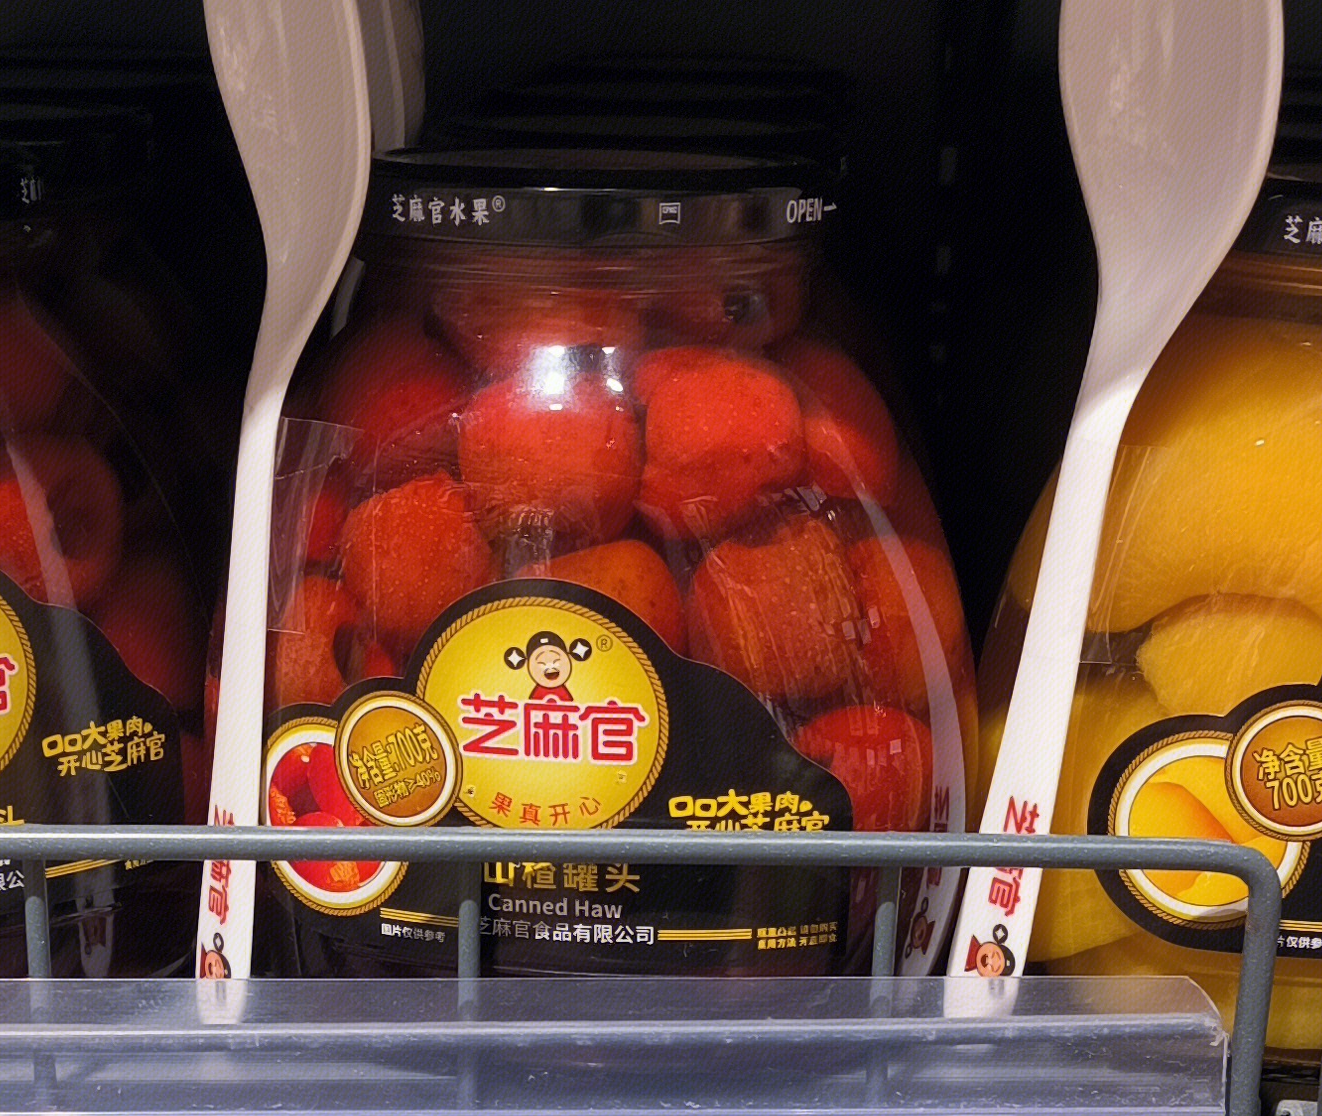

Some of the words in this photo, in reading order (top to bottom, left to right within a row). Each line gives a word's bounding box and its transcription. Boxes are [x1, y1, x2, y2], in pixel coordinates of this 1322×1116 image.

[391, 192, 490, 226] 芝麻官水果
[785, 197, 824, 225] OPEN
[459, 692, 646, 763] 芝麻官
[57, 732, 167, 777] 开心芝麻官
[490, 793, 603, 827] 果真开心
[988, 795, 1041, 917] 芝官
[483, 862, 641, 895] 山楂罐头
[488, 893, 568, 917] Canned
[574, 898, 623, 919] Haw
[479, 915, 656, 946] 芝麻官食品有限公司
